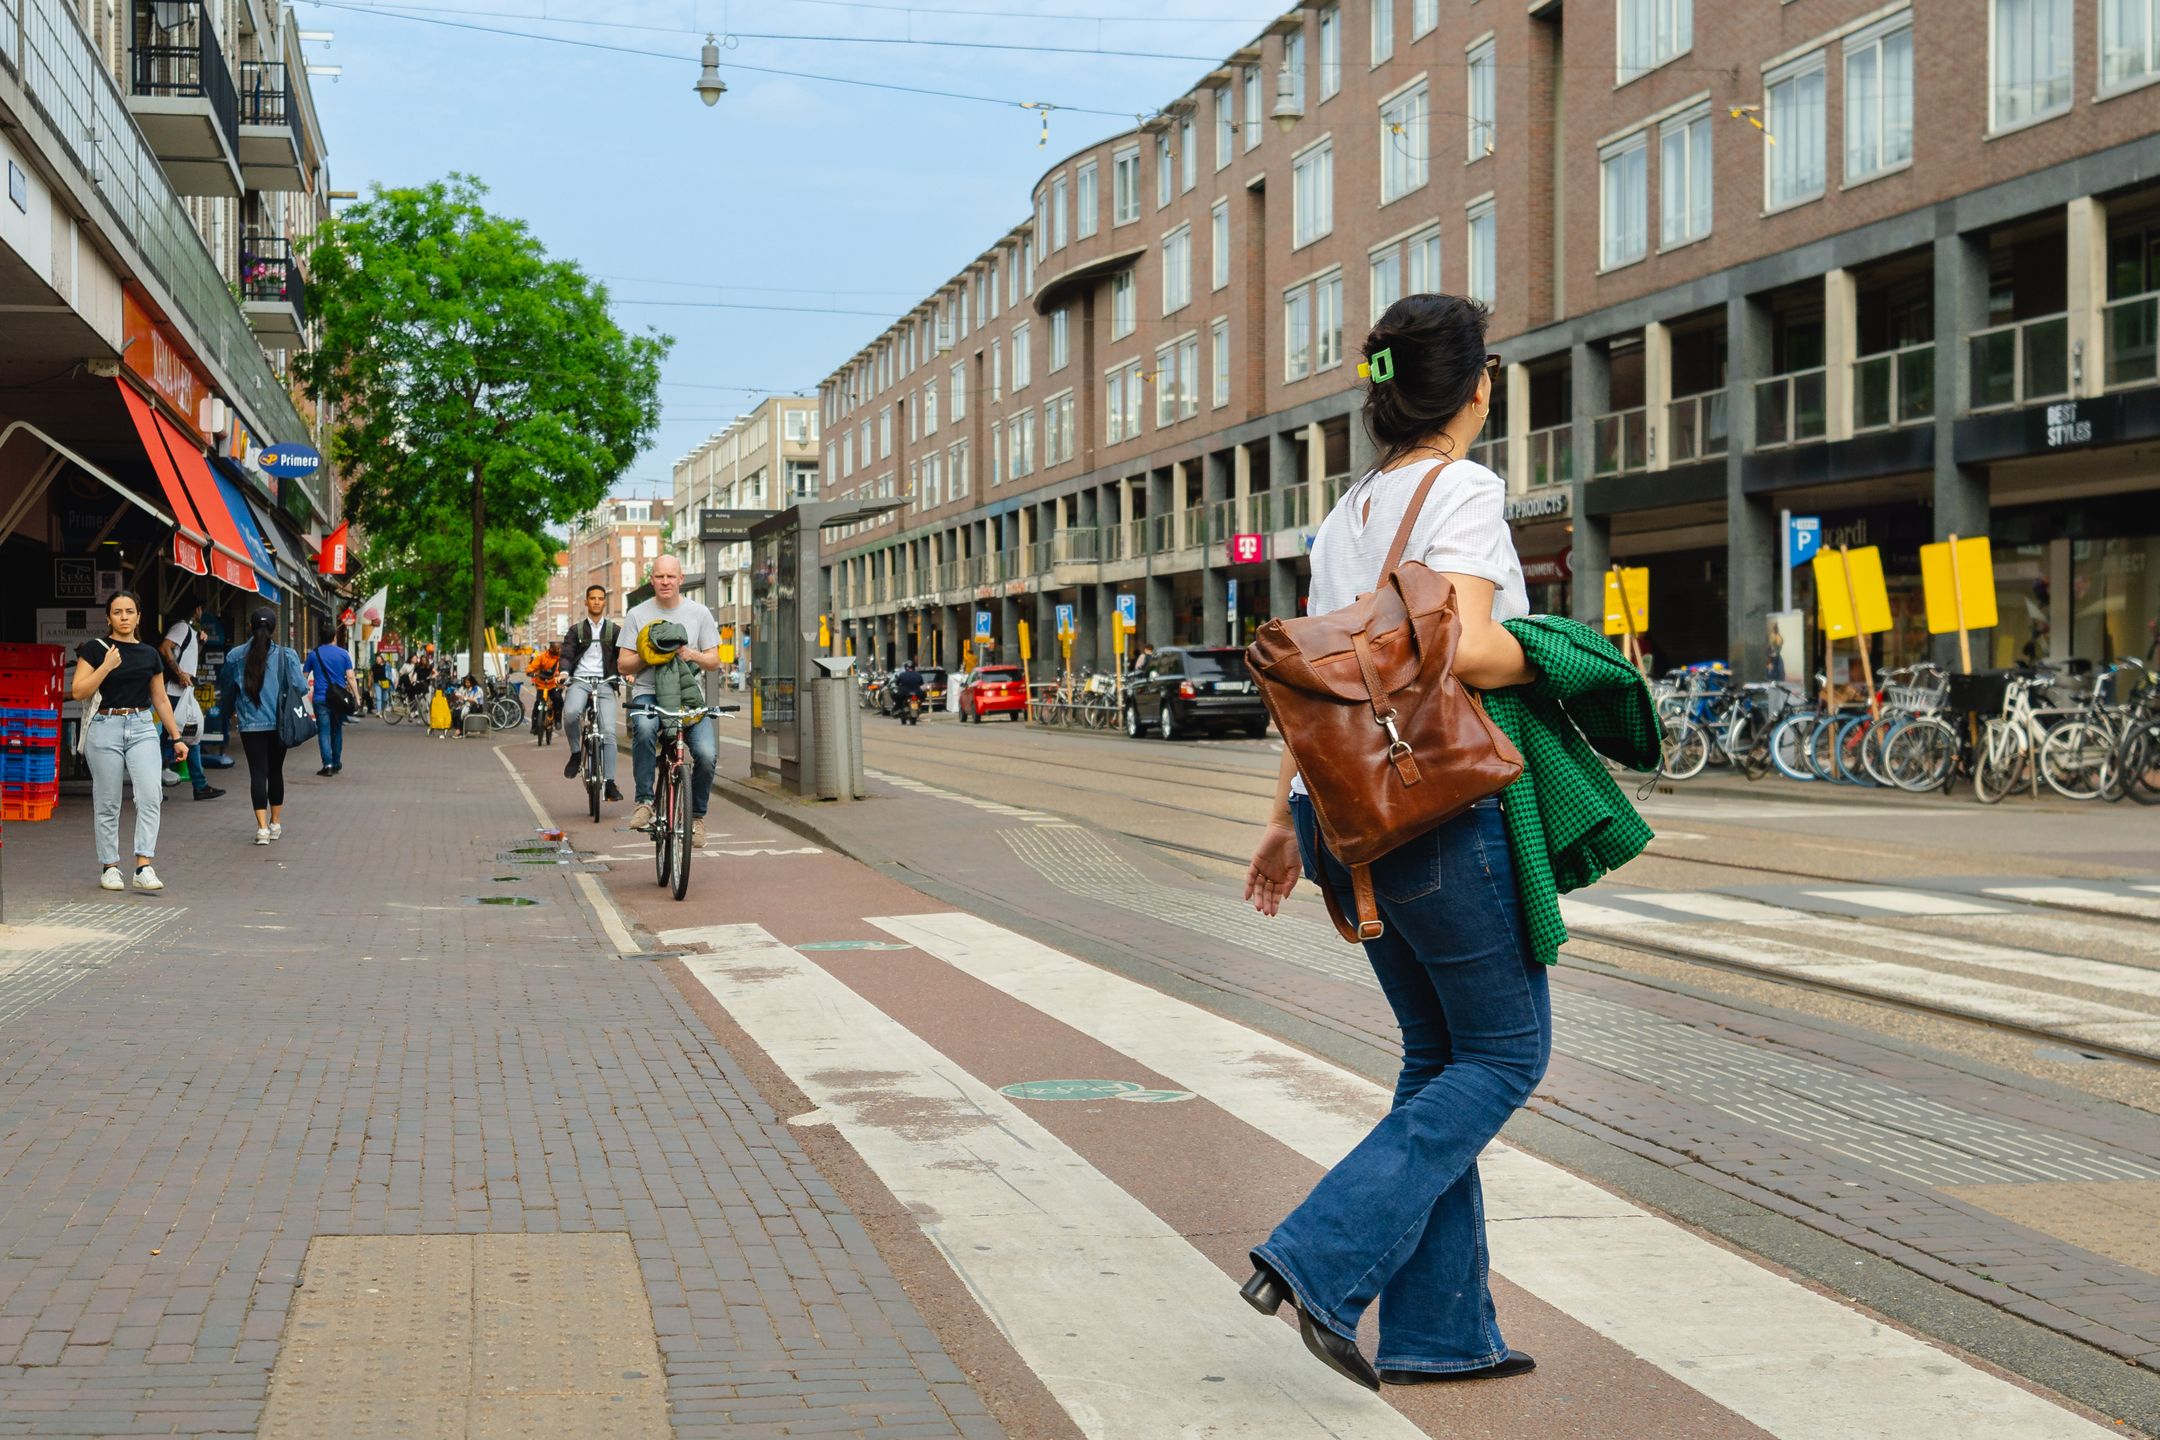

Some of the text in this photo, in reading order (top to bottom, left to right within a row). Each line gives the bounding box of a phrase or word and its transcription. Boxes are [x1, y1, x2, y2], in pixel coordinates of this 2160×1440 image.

[2047, 402, 2078, 427] BEST
[2047, 420, 2093, 447] STYLES
[280, 453, 319, 467] Primera
[1516, 496, 1561, 518] PRODUCTS
[1238, 537, 1257, 559] T
